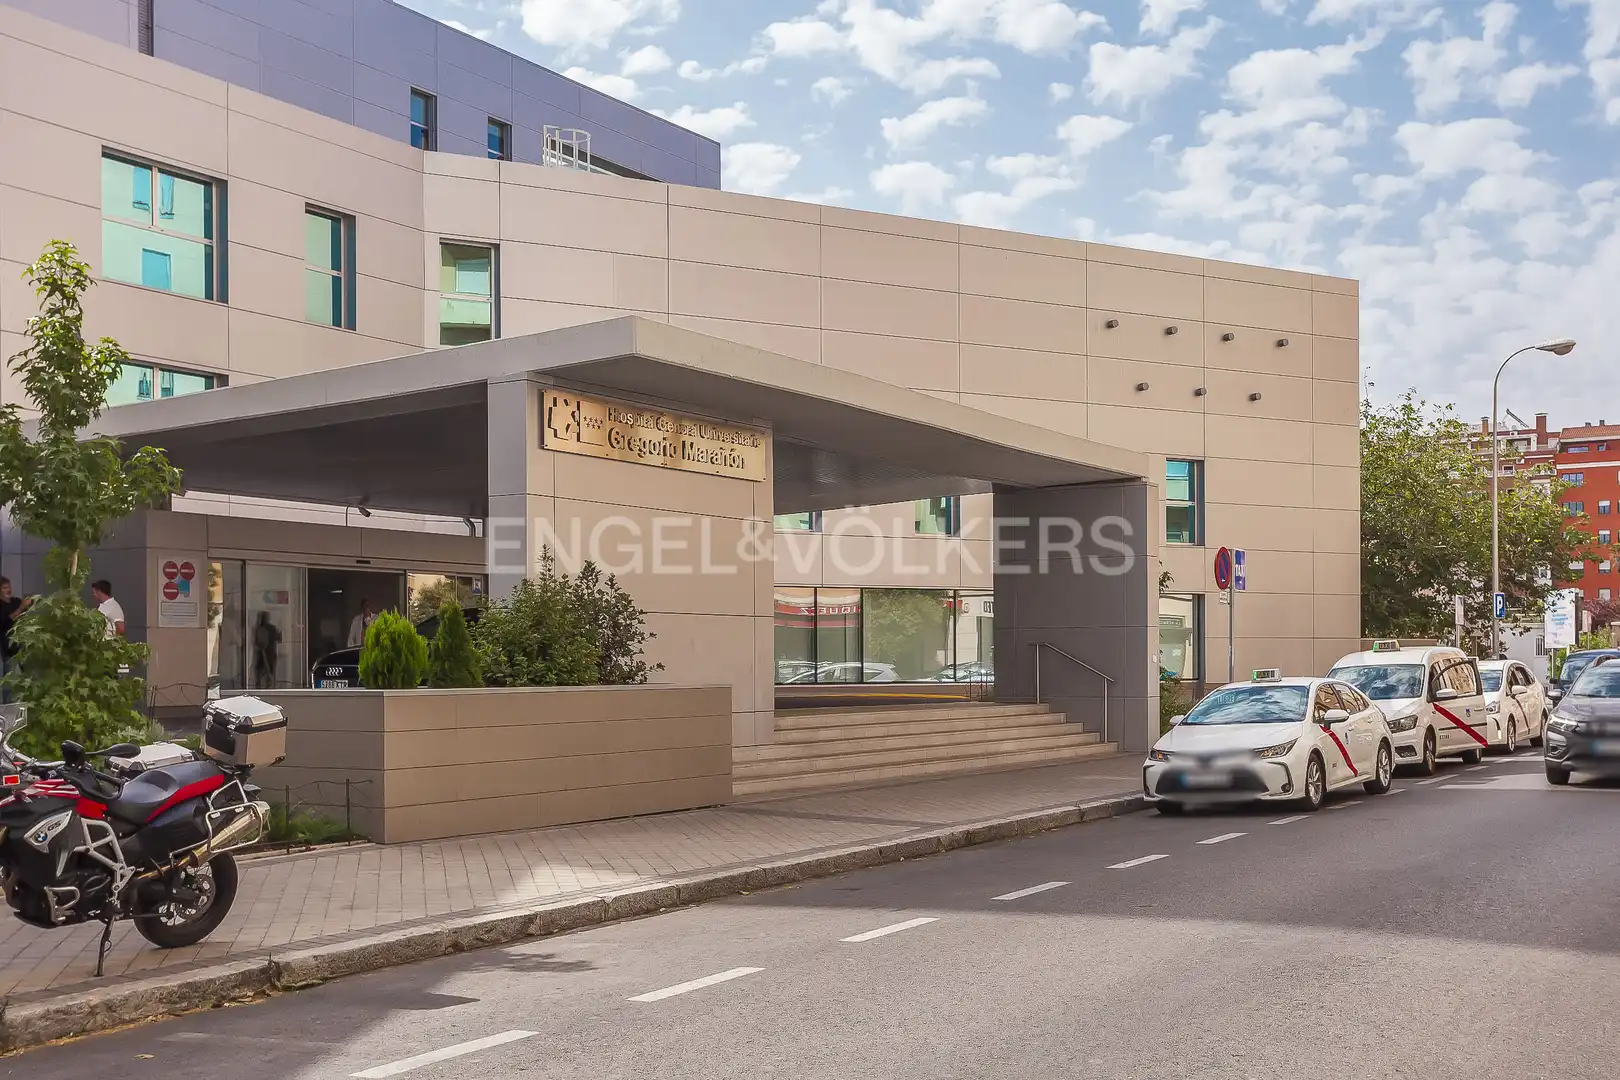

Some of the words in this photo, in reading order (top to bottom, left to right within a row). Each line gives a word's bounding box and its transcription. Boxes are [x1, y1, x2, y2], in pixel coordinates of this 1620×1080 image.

[607, 407, 655, 430] Hospital
[655, 413, 698, 437] General
[607, 426, 677, 459] Gregorio
[681, 439, 746, 469] Marañón
[1496, 595, 1503, 617] P
[47, 820, 61, 831] GS
